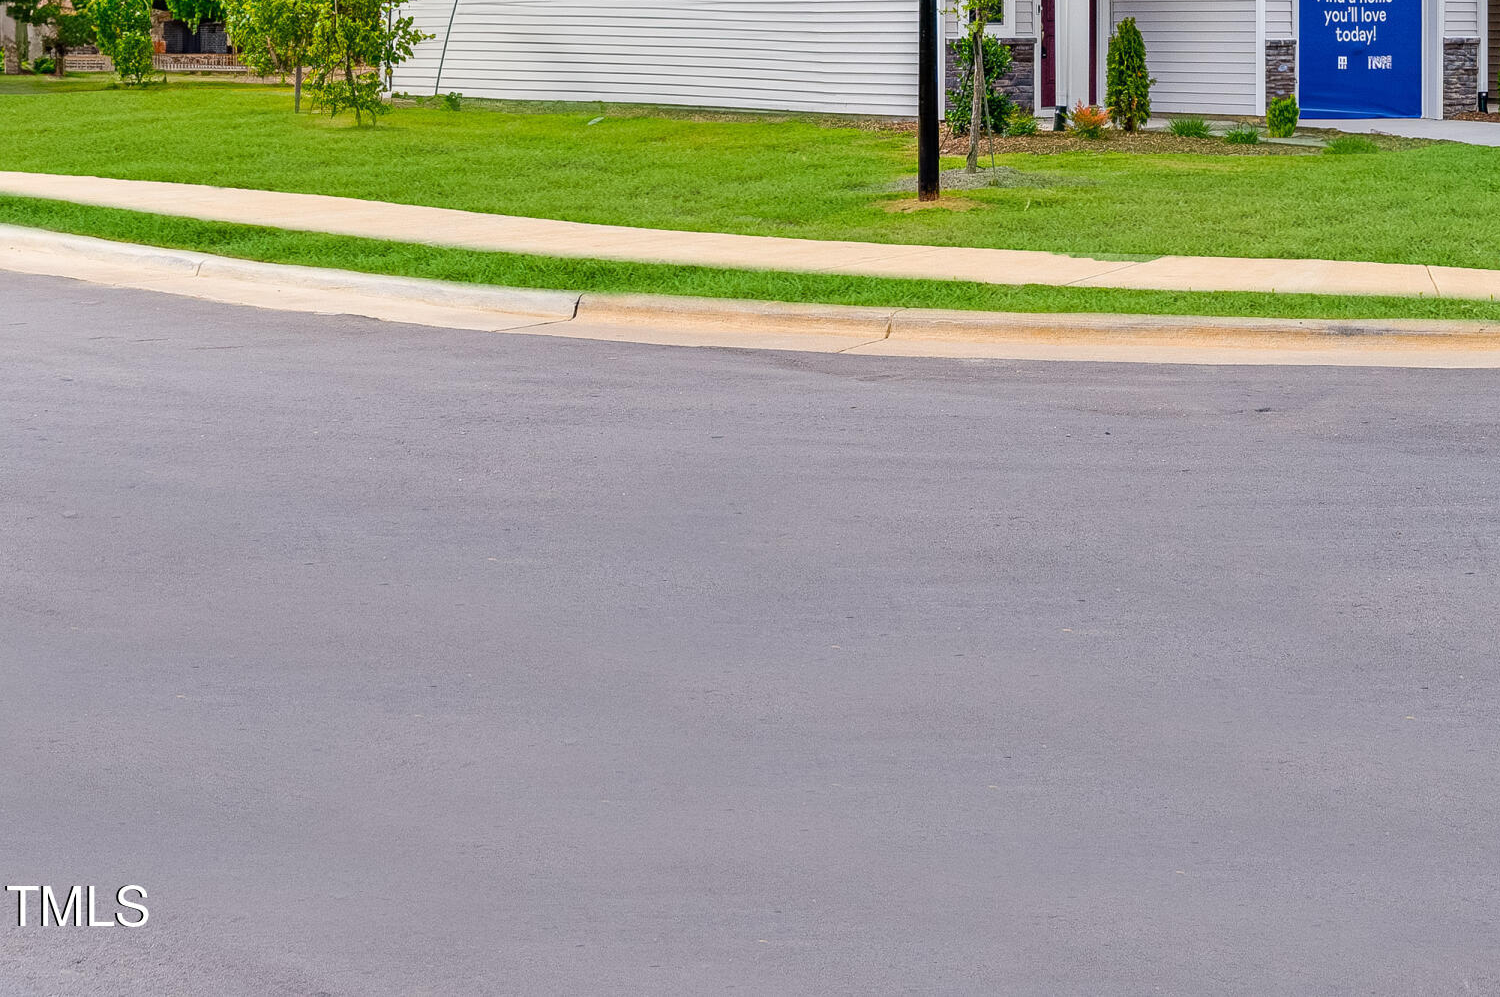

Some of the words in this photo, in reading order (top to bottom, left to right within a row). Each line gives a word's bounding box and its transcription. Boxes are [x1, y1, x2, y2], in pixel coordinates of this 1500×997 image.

[1324, 6, 1358, 26] you'll
[1361, 6, 1387, 22] love
[1335, 25, 1377, 45] today!
